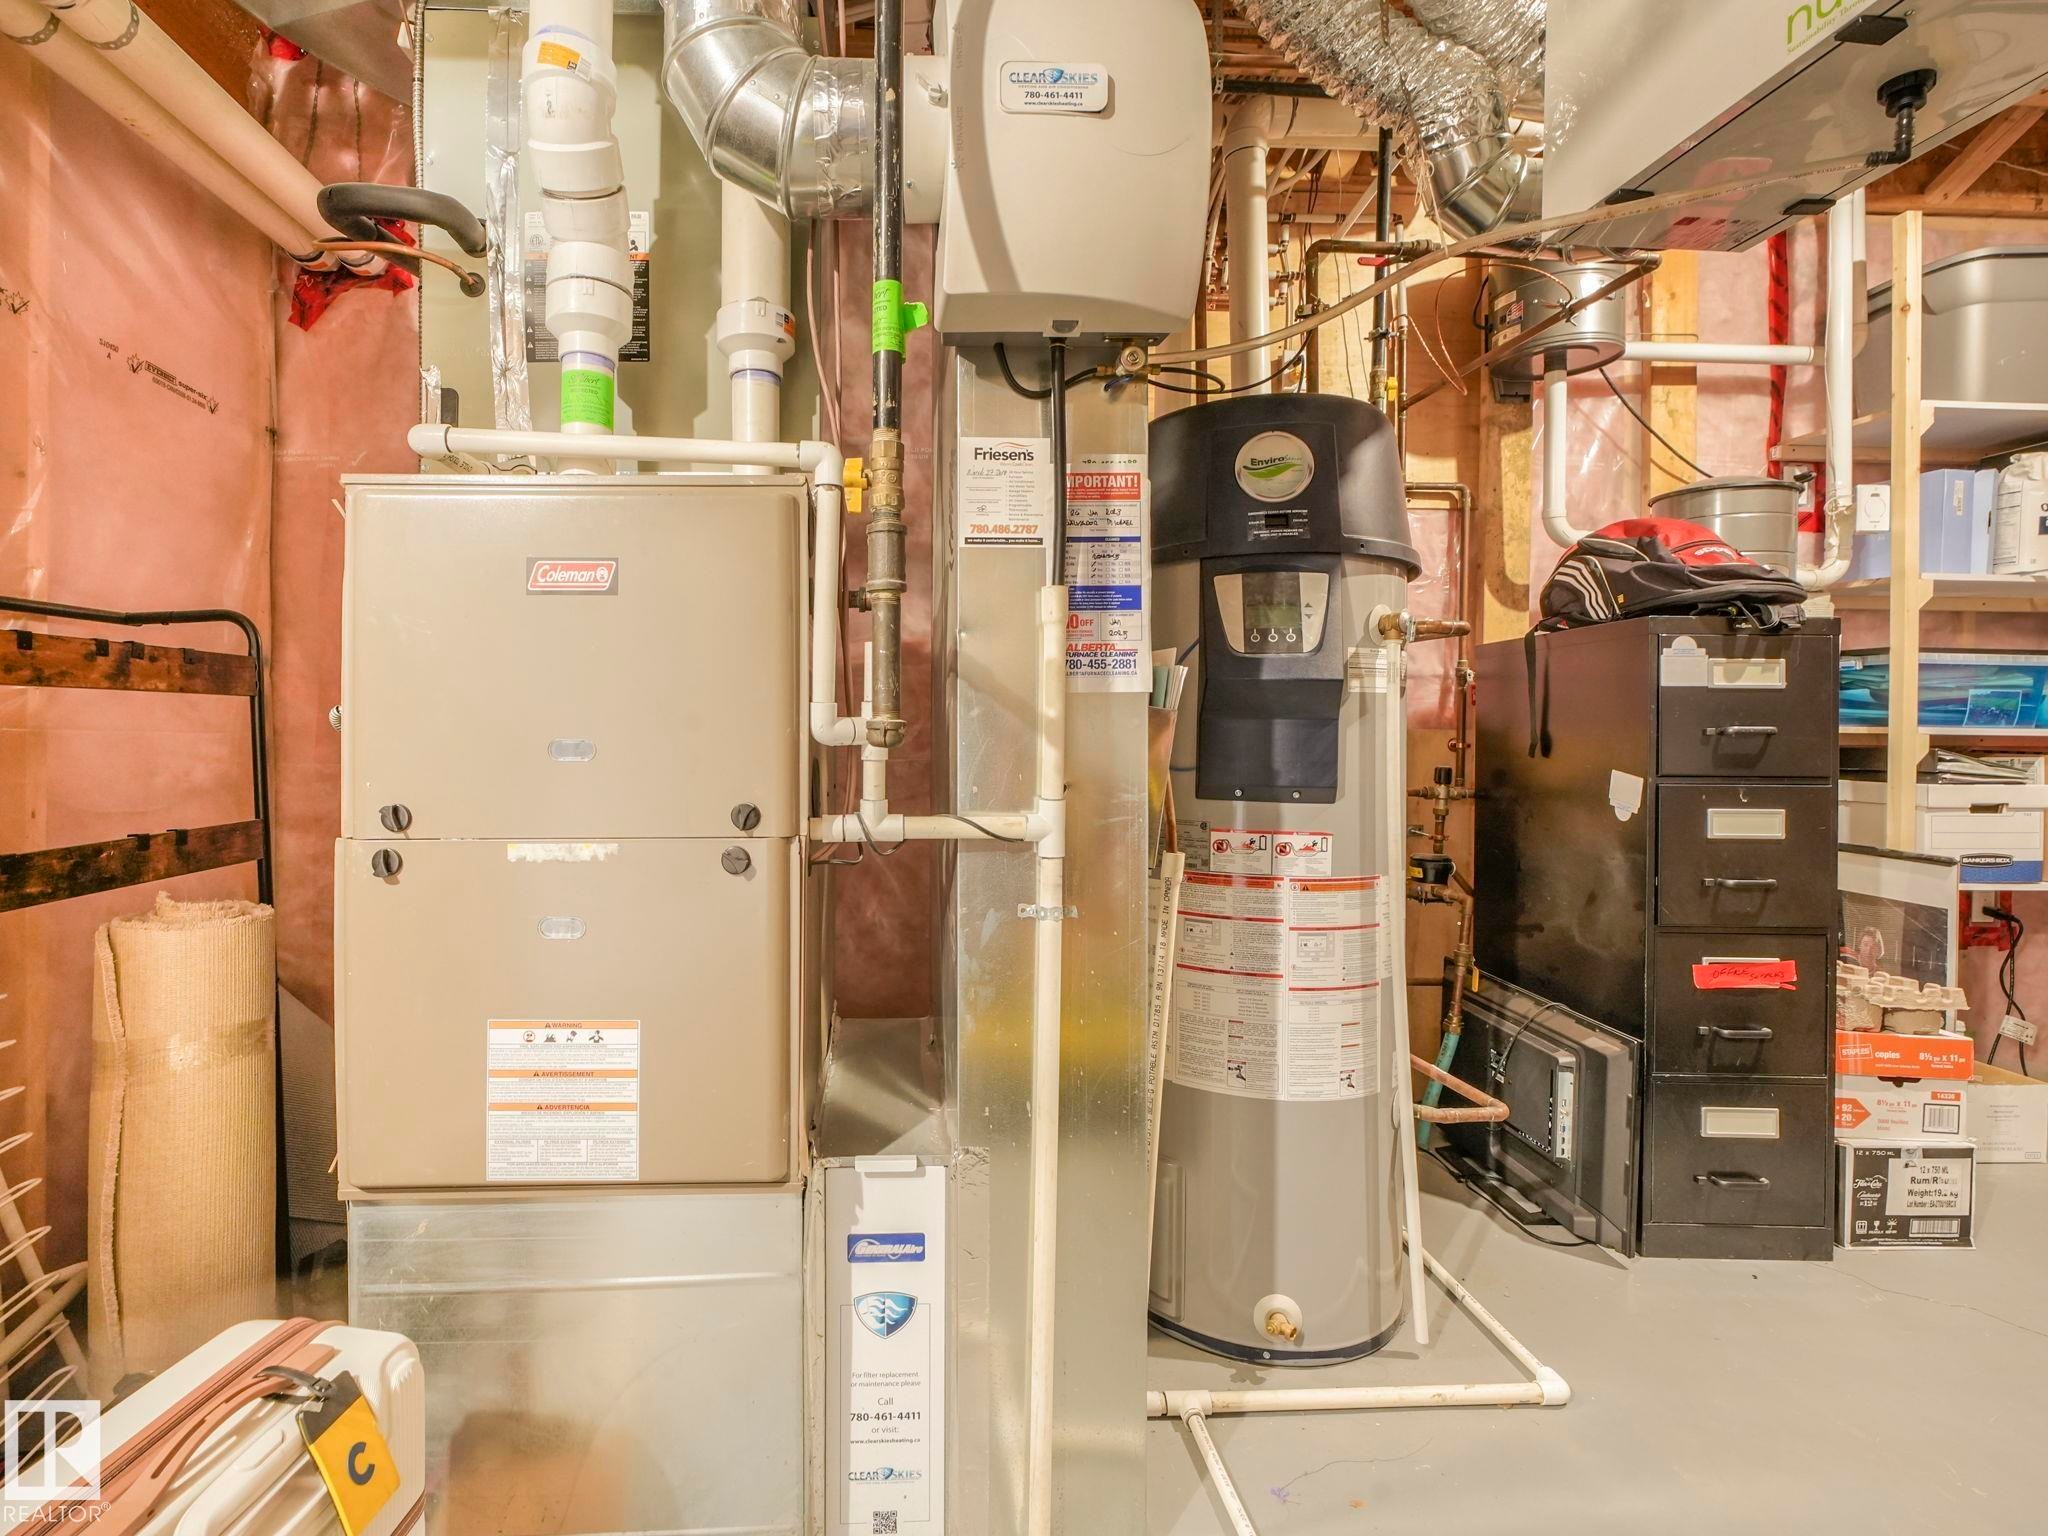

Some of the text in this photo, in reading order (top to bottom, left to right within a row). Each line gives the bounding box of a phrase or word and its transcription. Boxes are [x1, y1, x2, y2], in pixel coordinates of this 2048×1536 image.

[1008, 72, 1098, 84] CLEAR SKIES
[1024, 91, 1083, 99] 780-461-4411
[974, 447, 1034, 461] Friesen's
[1066, 475, 1138, 488] MPORTANT!
[970, 524, 1038, 534] 780.486.2787
[537, 564, 595, 582] Coleman
[1067, 643, 1116, 652] ALBERTA
[1066, 660, 1136, 670] 780-455-2881
[1162, 905, 1170, 915] IN
[1160, 919, 1169, 938] MADE
[1160, 942, 1166, 950] 18
[1157, 956, 1166, 978] 13714
[1153, 1004, 1161, 1028] D1785
[1875, 1050, 1900, 1060] copies
[1148, 1054, 1158, 1086] POTABLE
[1842, 1104, 1852, 1112] 92
[878, 1397, 894, 1405] Call
[850, 1412, 921, 1421] 780-461-4411
[848, 1470, 922, 1481] CLEAR SKIES
